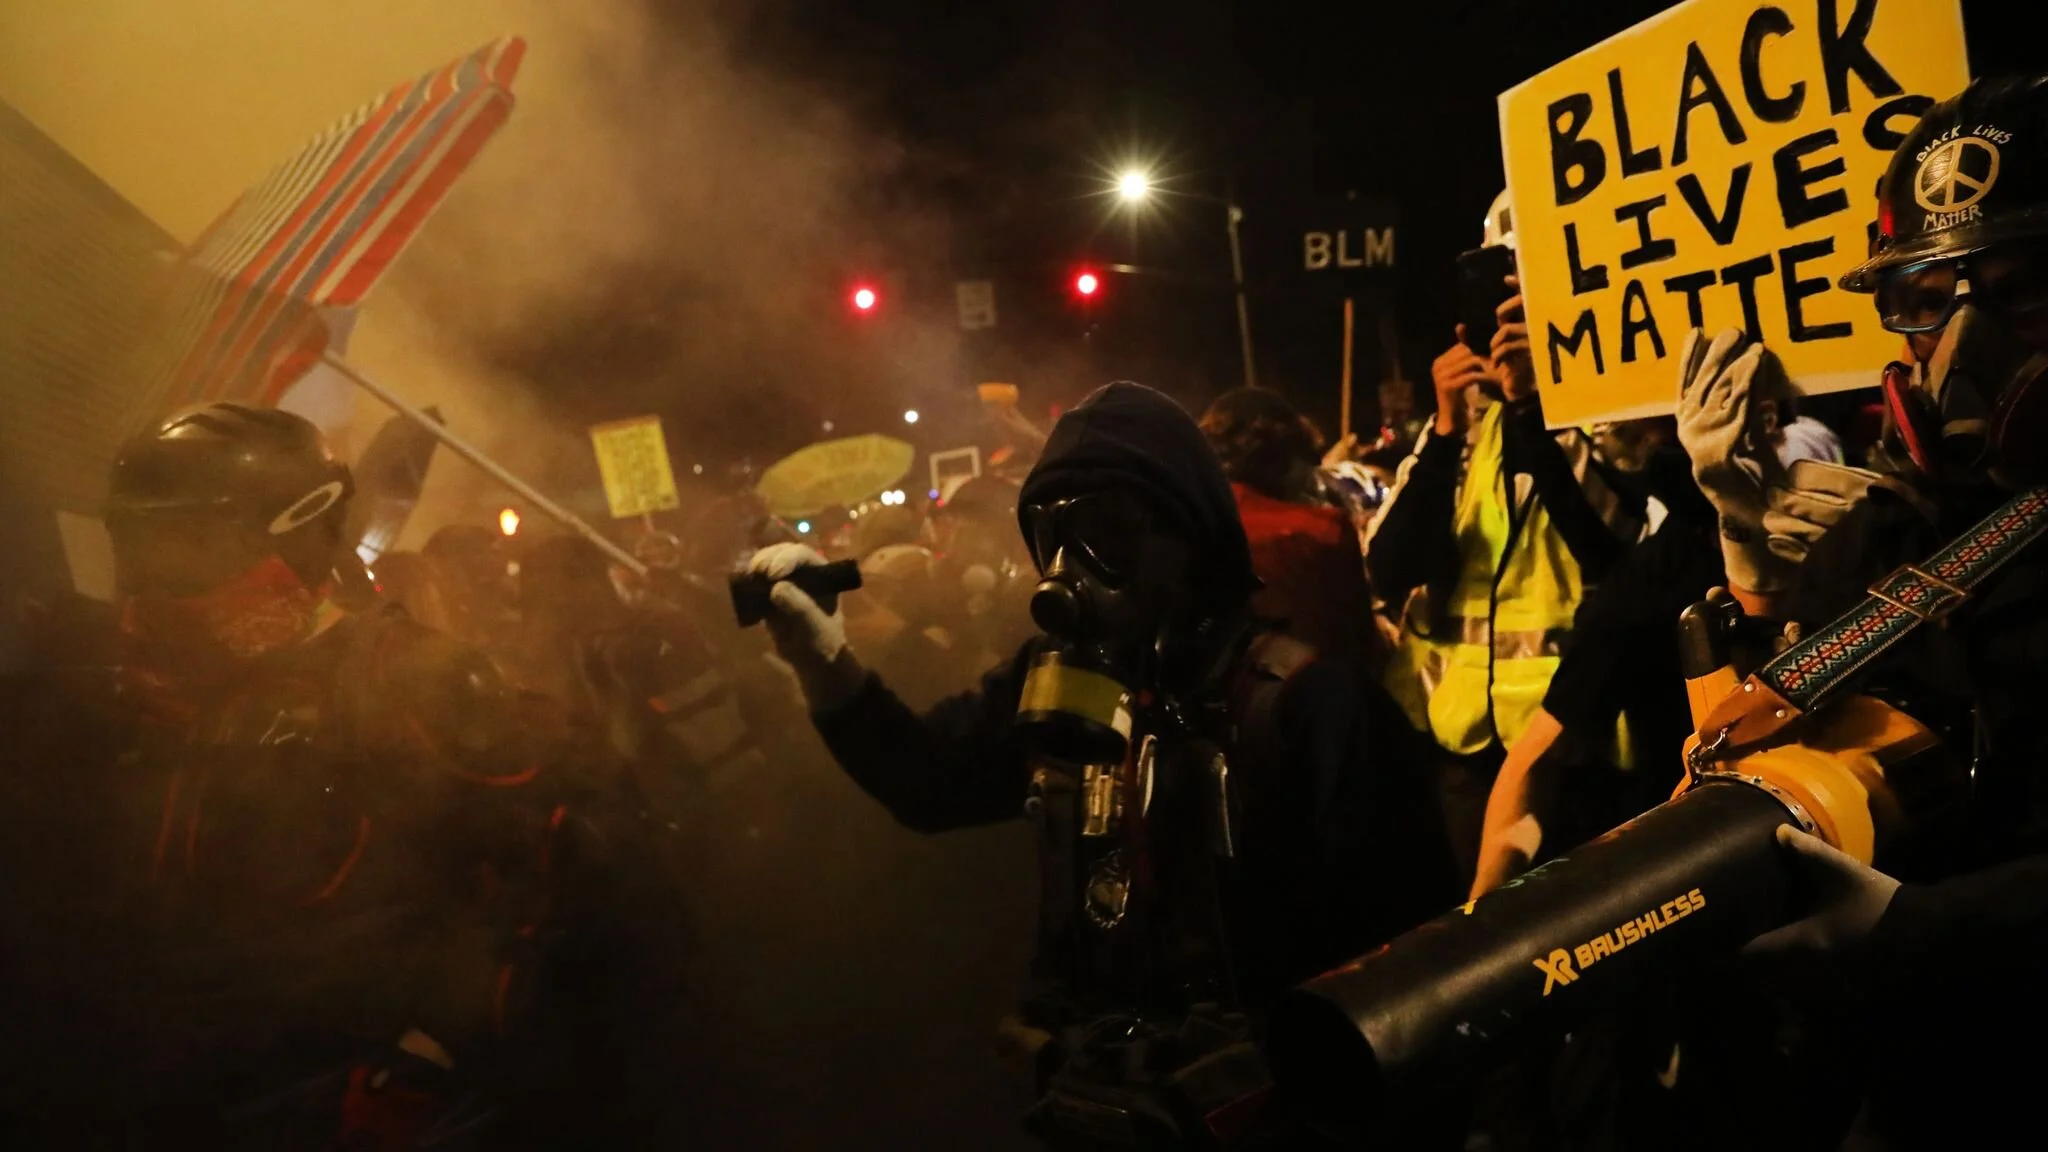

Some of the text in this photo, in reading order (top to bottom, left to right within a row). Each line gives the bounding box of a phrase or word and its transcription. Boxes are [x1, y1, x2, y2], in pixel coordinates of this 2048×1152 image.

[1547, 0, 1905, 207] BLACK
[1303, 226, 1395, 271] BLM
[1923, 205, 1983, 230] MATTER
[1547, 221, 1879, 384] MATTE
[1532, 887, 1707, 997] XR BRUSHLESS
